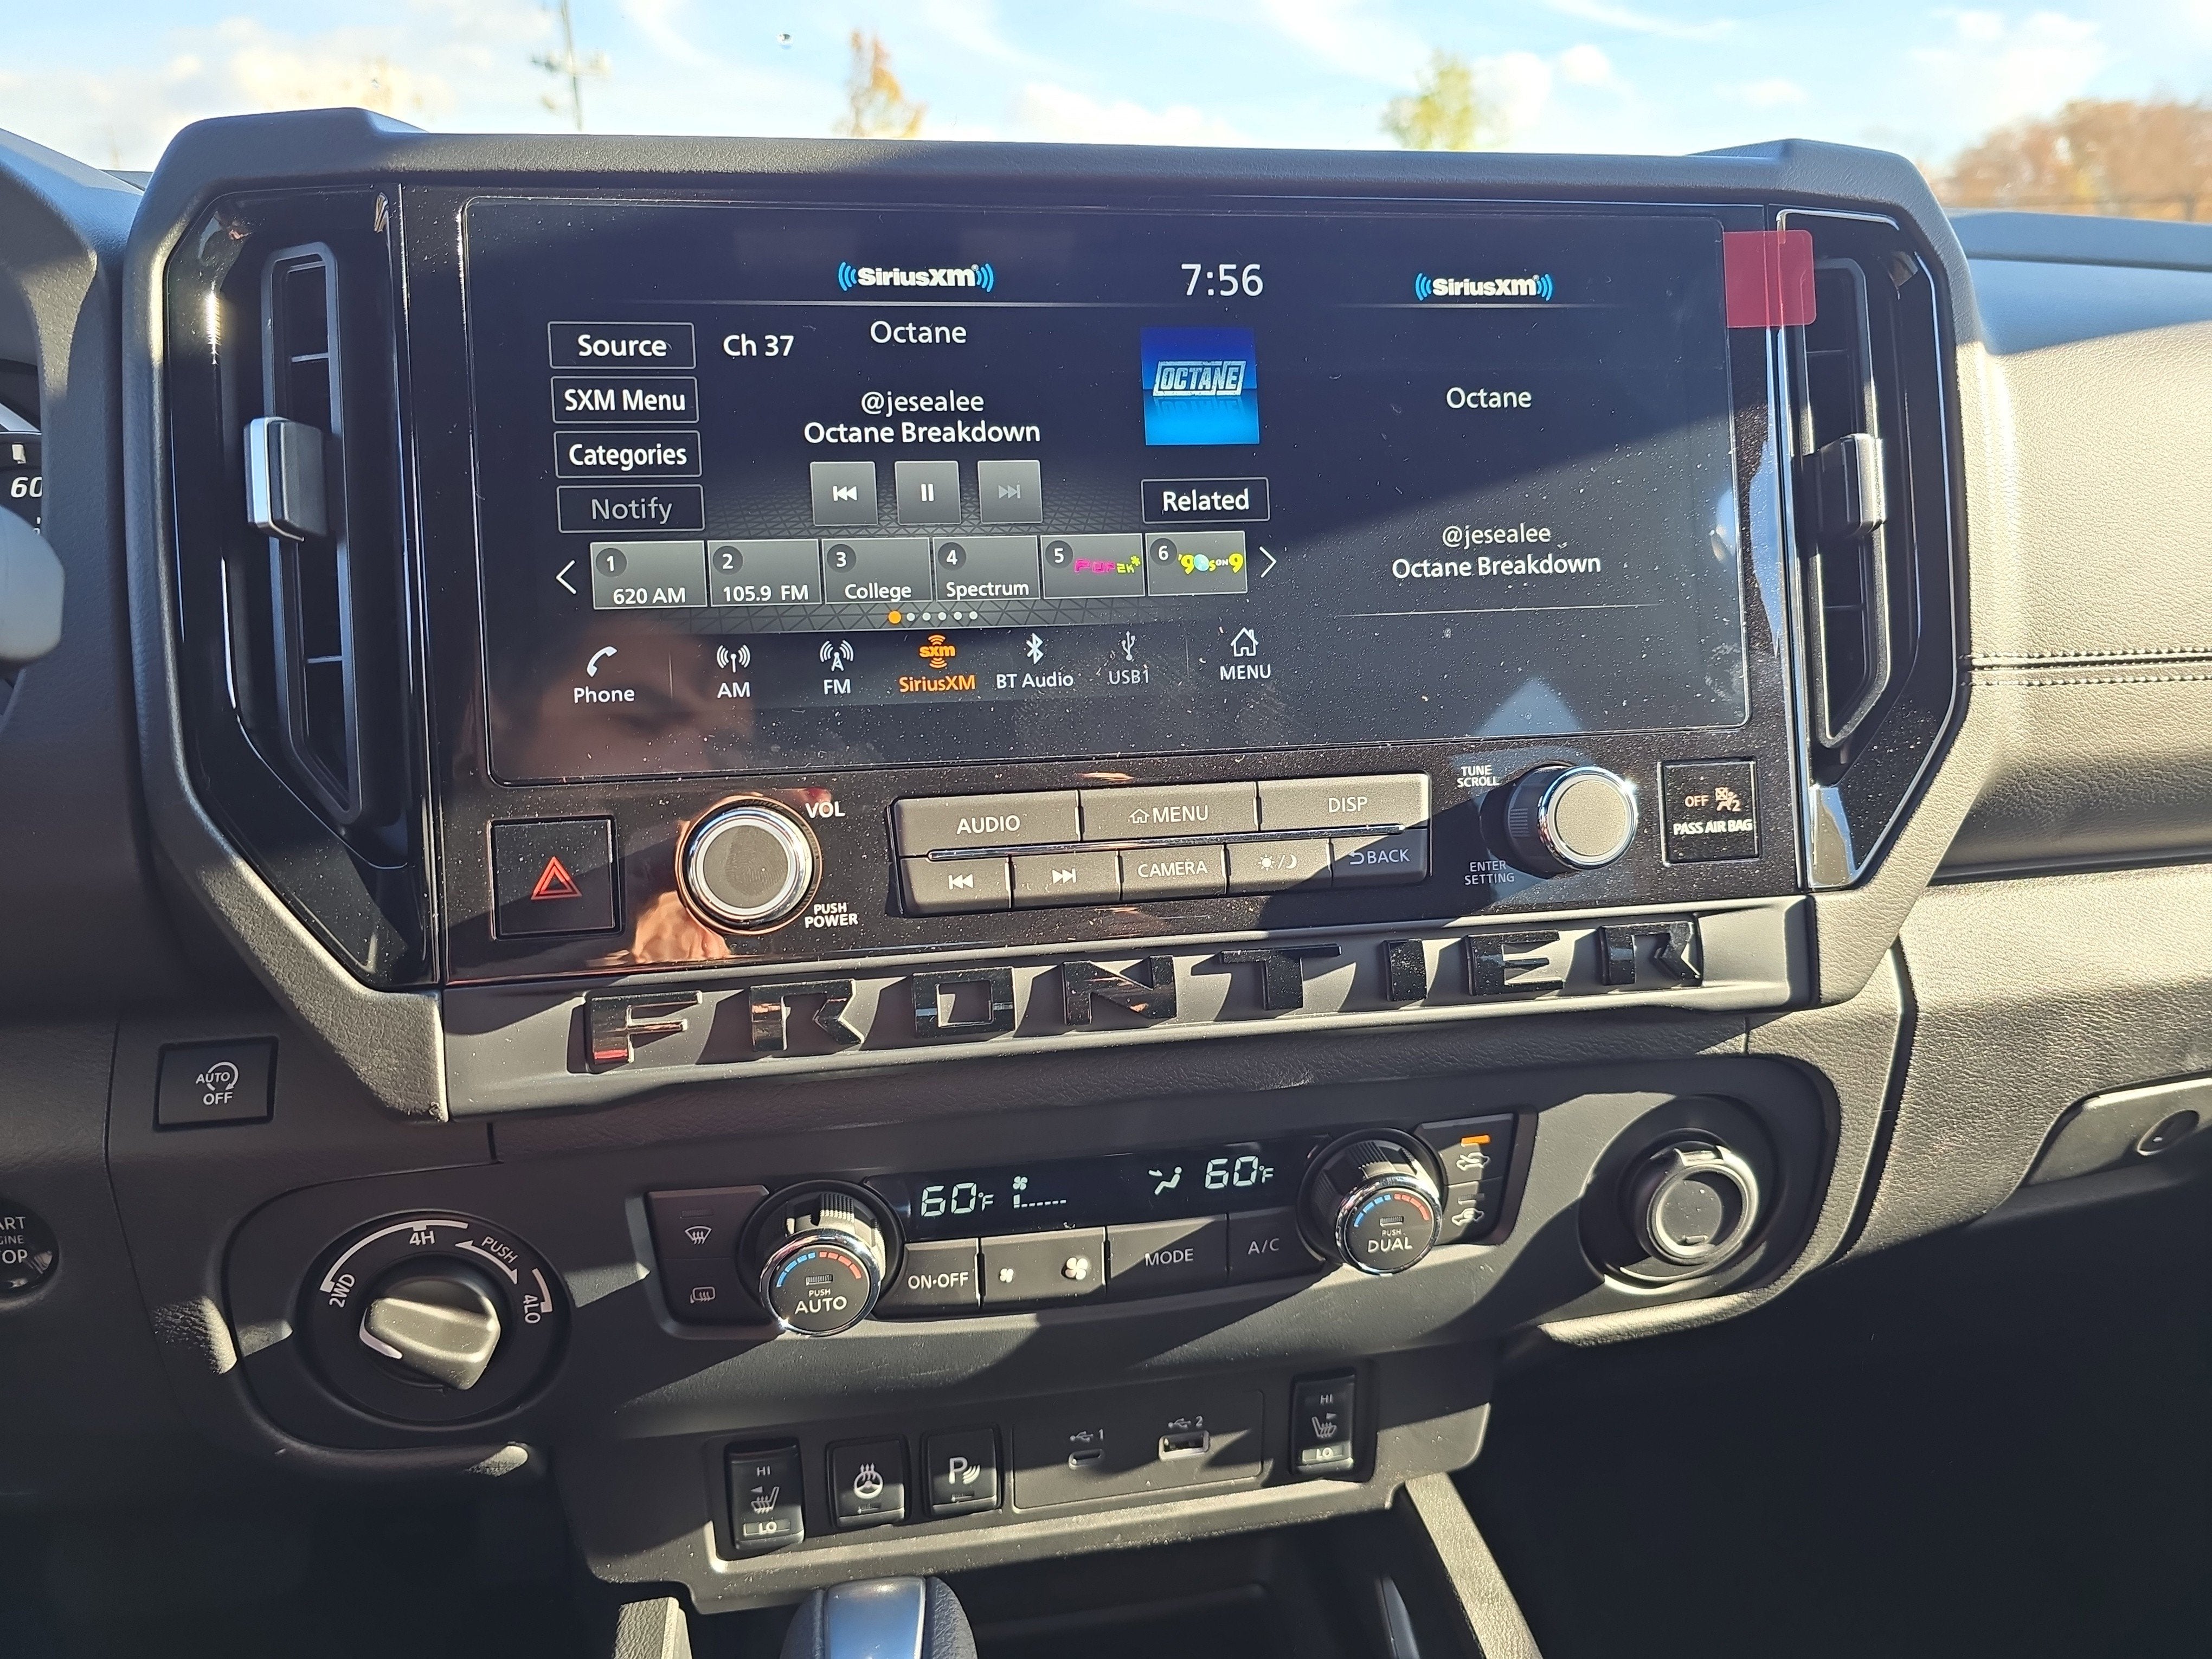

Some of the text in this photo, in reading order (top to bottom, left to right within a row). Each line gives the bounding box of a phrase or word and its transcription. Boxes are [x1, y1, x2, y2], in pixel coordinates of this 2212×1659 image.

[1181, 263, 1263, 297] 7:56
[871, 320, 966, 344] Octane
[578, 335, 667, 357] Source
[723, 334, 794, 357] Ch 37
[1160, 366, 1239, 390] OCTANE
[564, 389, 686, 411] SXM Menu
[861, 390, 984, 417] @jesealee
[1446, 387, 1532, 409] Octane
[805, 421, 1040, 443] Octane Breakdown
[569, 443, 687, 471] Categories
[1163, 489, 1249, 512] Related
[591, 498, 672, 525] Notify
[1442, 523, 1551, 549] @jesealee
[722, 554, 733, 569] 2
[836, 552, 847, 567] 3
[946, 550, 958, 565] 4
[1054, 548, 1064, 563] 5
[1158, 545, 1169, 561] 6
[606, 556, 615, 571] 1
[1392, 554, 1600, 578] Octane Breakdown
[613, 587, 686, 605] 620 AM
[723, 584, 808, 602] 105.9 FM
[845, 584, 912, 603] College
[946, 581, 1030, 599] Spectrum
[919, 644, 956, 658] sxm
[996, 670, 1074, 689] BT Audio
[1109, 668, 1150, 685] USB1
[1220, 663, 1271, 680] MENU
[717, 682, 750, 698] AM
[824, 678, 851, 694] FM
[899, 674, 976, 693] SiriusXM
[574, 686, 635, 703] Phone
[1461, 765, 1493, 776] TUNE
[1457, 775, 1500, 788] SCROLL
[1328, 796, 1368, 813] DISP
[1684, 795, 1709, 808] OFF
[805, 802, 845, 819] VOL
[1153, 805, 1208, 824] MENU
[956, 815, 1020, 835] AUDIO
[1673, 819, 1752, 835] PASS AIR BAG
[1367, 849, 1410, 865] BACK
[1138, 859, 1207, 878] CAMERA
[1469, 860, 1506, 872] ENTER
[1464, 871, 1515, 885] SETTING
[813, 903, 847, 915] PUSH
[805, 912, 859, 929] POWER
[585, 920, 1702, 1069] FRONTIER
[195, 1071, 230, 1085] AUTO
[203, 1092, 233, 1105] OFF
[409, 1230, 435, 1245] 4H
[1381, 1228, 1403, 1237] PUSH
[481, 1236, 518, 1264] PUSH
[1248, 1237, 1279, 1255] A/C
[1367, 1237, 1413, 1253] DUAL
[1144, 1249, 1193, 1266] MODE
[329, 1274, 355, 1308] 2WD
[808, 1287, 832, 1297] PUSH
[523, 1294, 541, 1324] 4LO
[794, 1296, 847, 1314] AUTO
[1320, 1394, 1333, 1404] HI
[1195, 1416, 1203, 1429] 2
[1098, 1429, 1104, 1441] 1
[1316, 1447, 1333, 1459] LO
[757, 1466, 771, 1476] HI
[759, 1521, 776, 1534] LO
